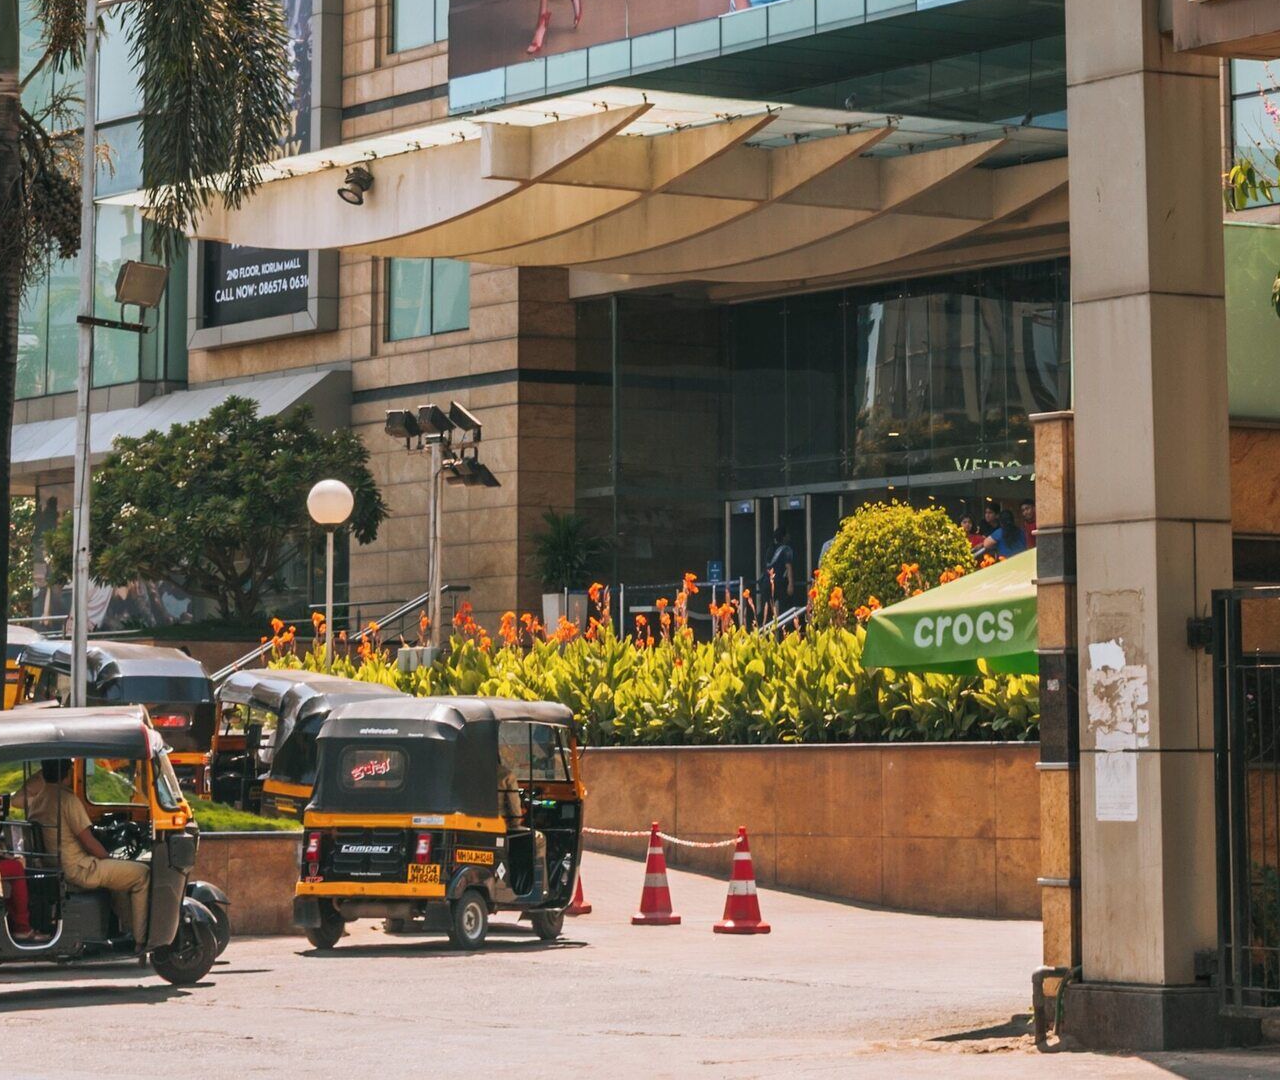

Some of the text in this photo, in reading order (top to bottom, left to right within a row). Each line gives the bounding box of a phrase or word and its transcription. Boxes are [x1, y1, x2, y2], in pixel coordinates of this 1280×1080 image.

[226, 257, 301, 281] 2ND FLOOR, KORUM MALL
[215, 287, 234, 302] CALL
[236, 284, 257, 300] NOW:
[259, 279, 288, 296] 086574
[914, 609, 1014, 648] crocs
[341, 844, 393, 854] Compact
